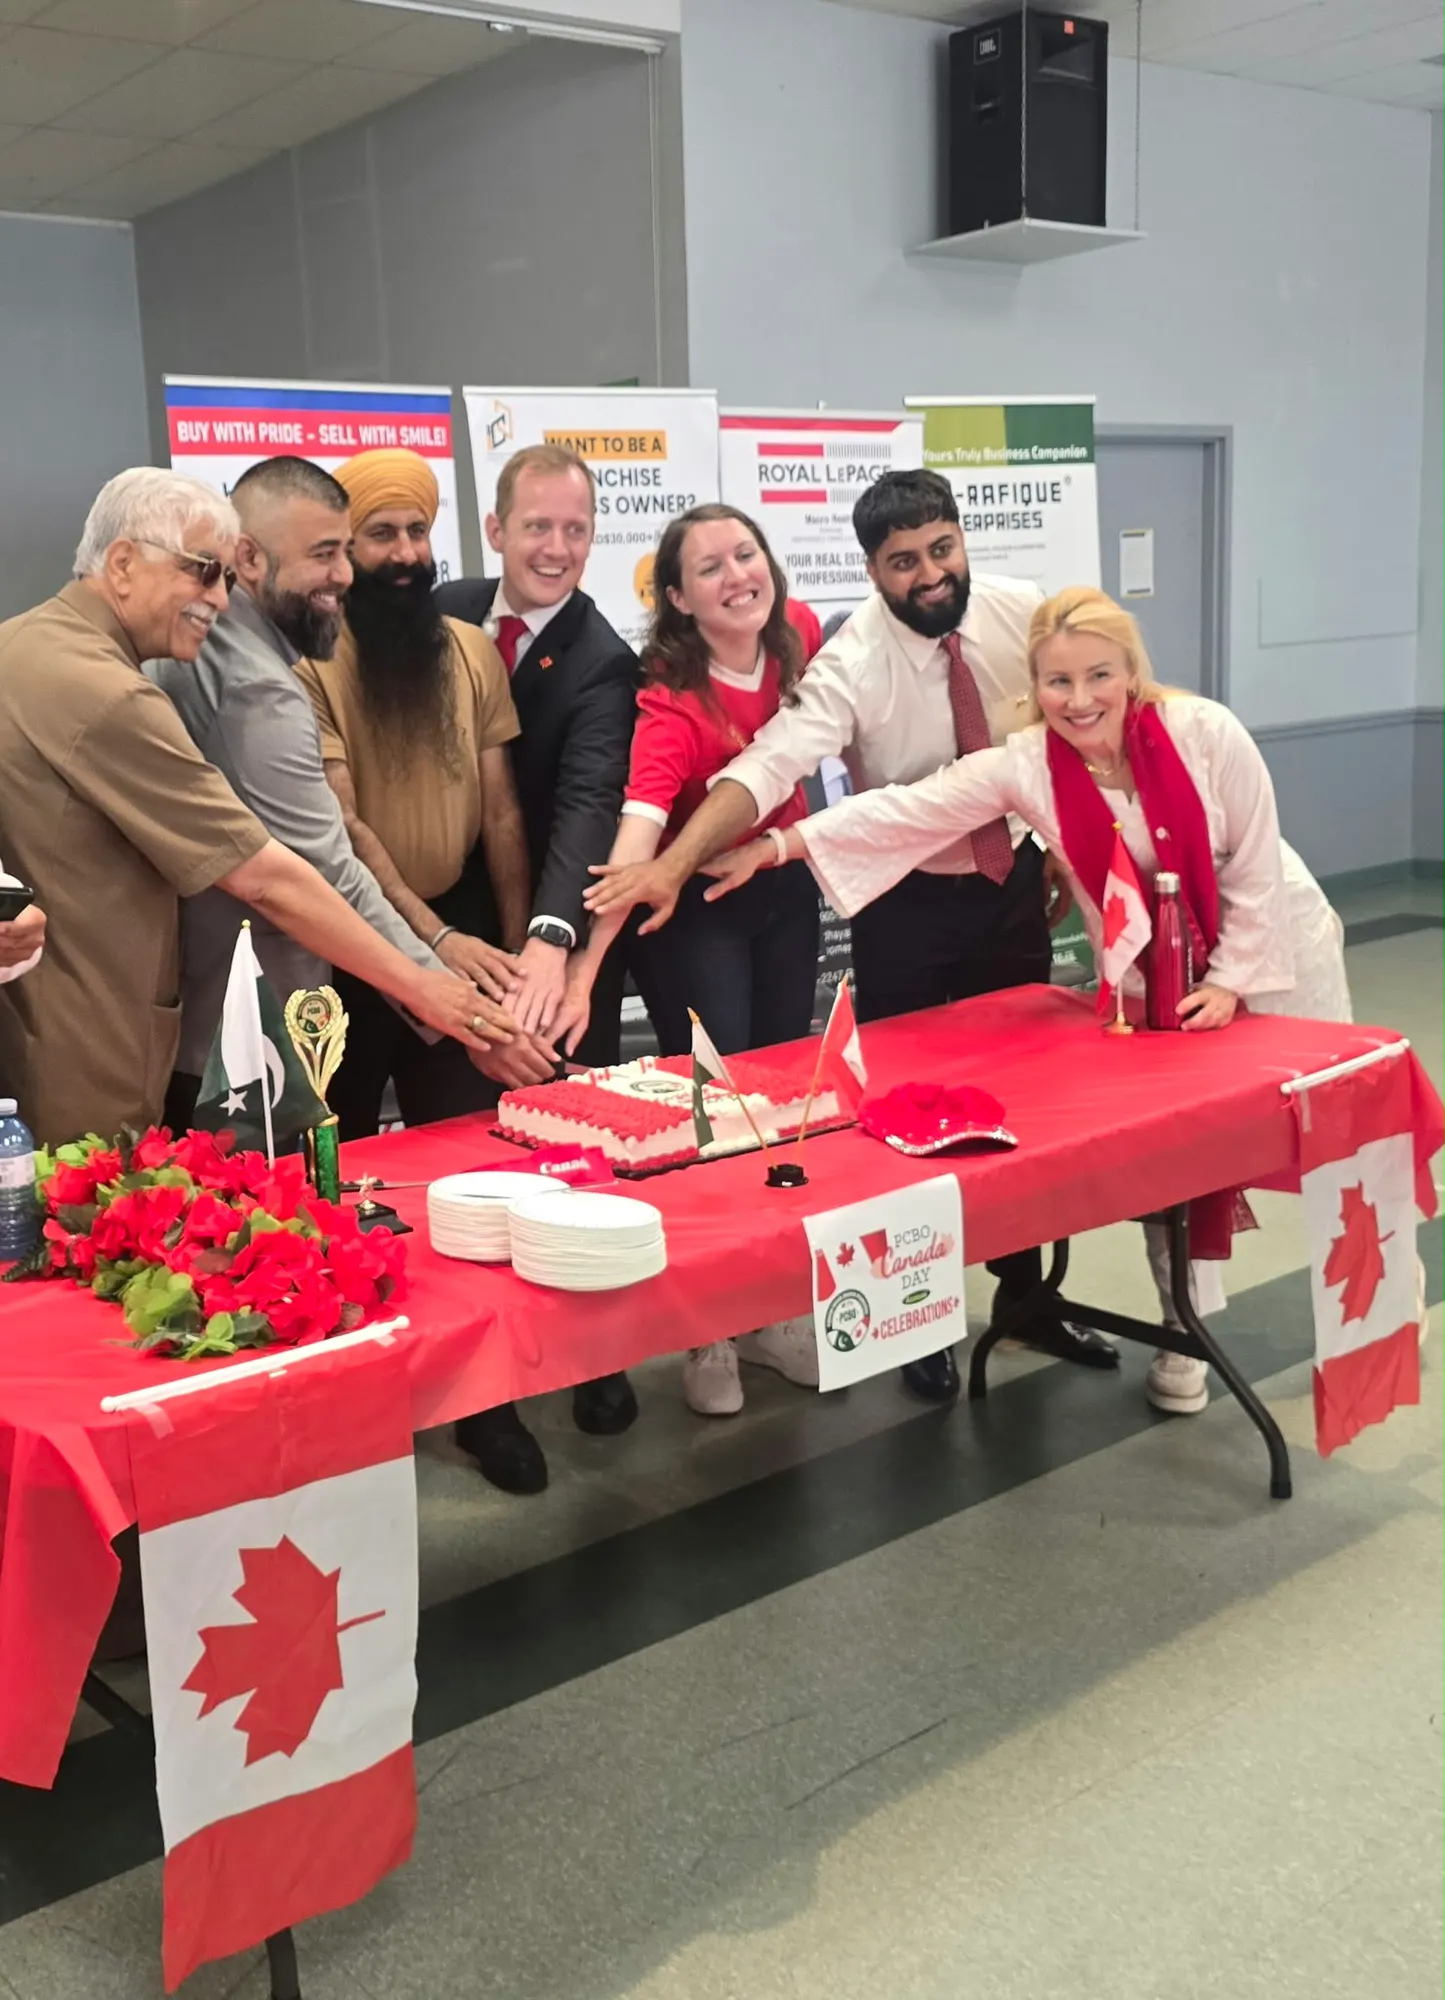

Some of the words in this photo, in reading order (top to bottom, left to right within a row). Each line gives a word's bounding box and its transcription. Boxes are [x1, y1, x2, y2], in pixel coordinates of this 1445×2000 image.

[177, 421, 208, 443] BUY
[212, 421, 255, 443] WITH
[258, 422, 303, 444] PRIDE
[319, 424, 357, 446] SELL
[359, 425, 397, 446] WITH
[400, 426, 447, 447] SMILE!
[602, 437, 624, 453] TO
[628, 437, 647, 453] BE
[652, 437, 662, 453] A
[956, 447, 982, 463] Truly
[983, 447, 1030, 461] Business
[1031, 444, 1088, 462] Companion
[590, 467, 662, 488] NCHISE
[758, 464, 821, 483] ROYAL
[616, 494, 696, 515] OWNER?
[955, 481, 1062, 507] -RAFIQUE
[963, 511, 1042, 532] ERPRISES
[785, 554, 812, 568] YOUR
[814, 553, 842, 567] REAL
[894, 1225, 931, 1248] PCBO
[881, 1231, 949, 1279] Canada
[901, 1266, 931, 1290] DAY
[880, 1296, 953, 1340] CELEBRATIONS
